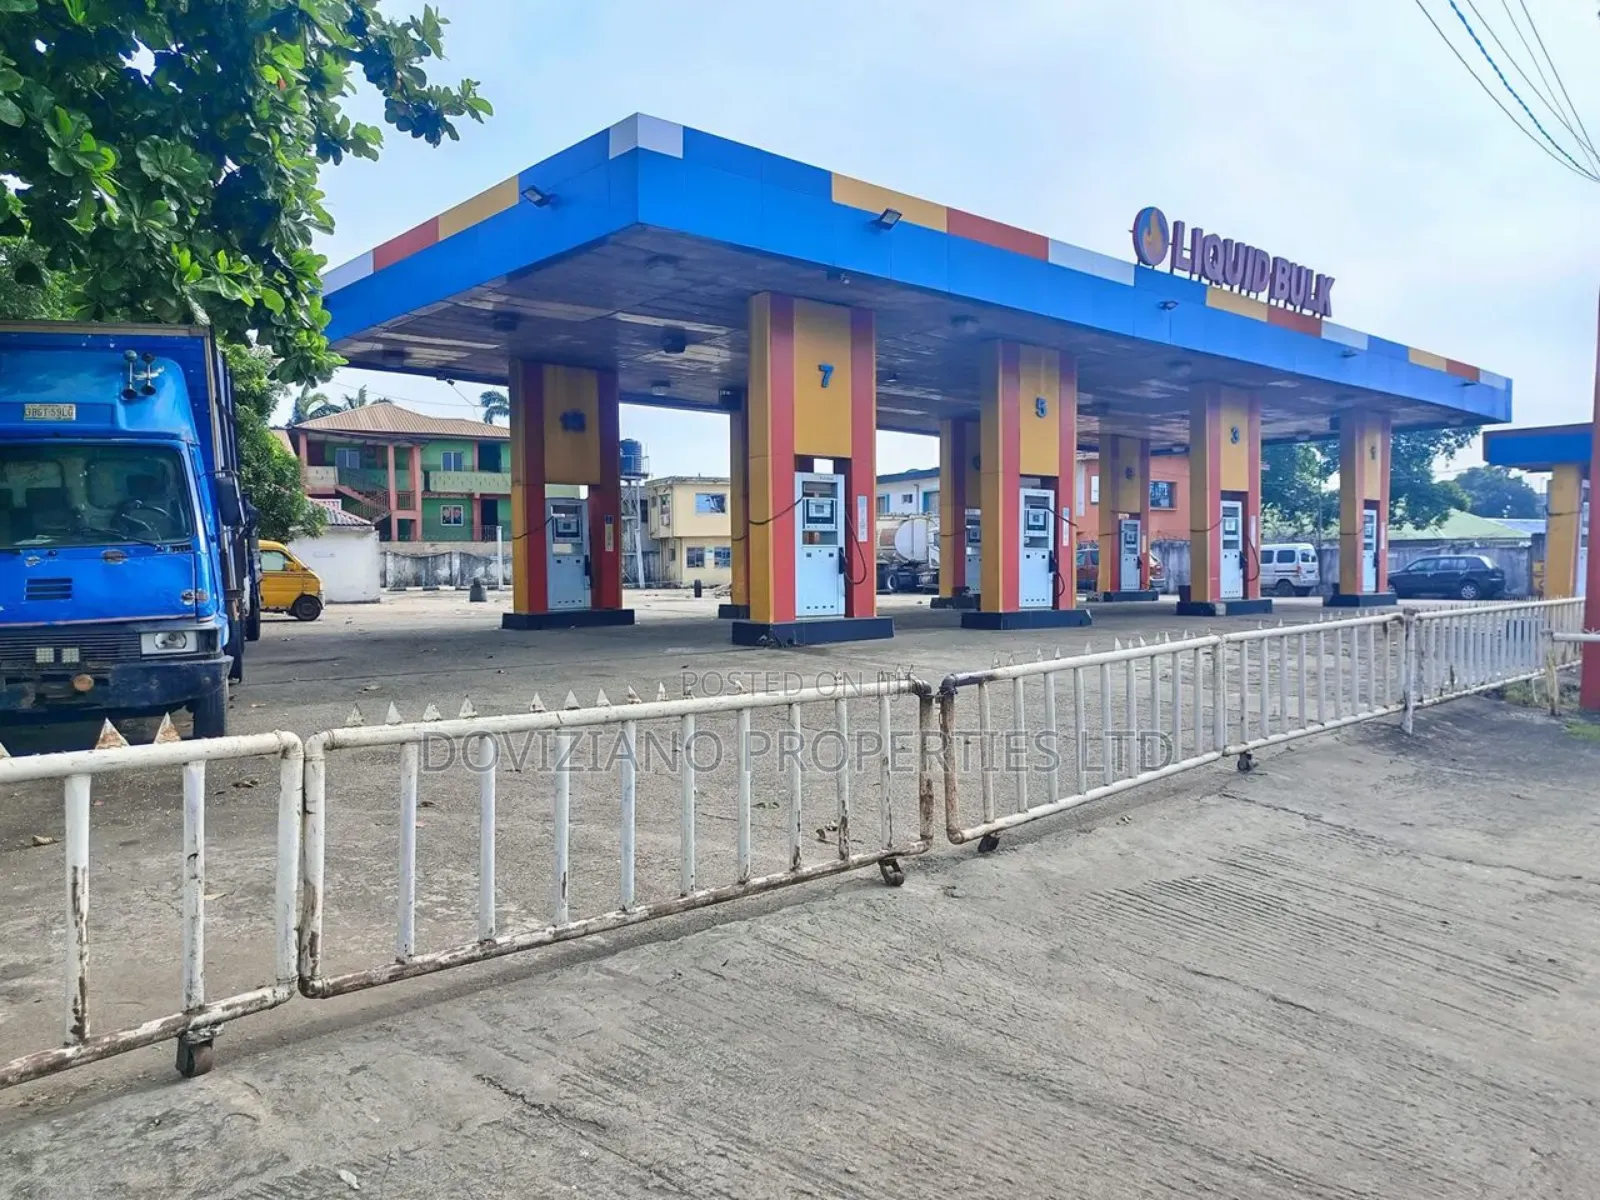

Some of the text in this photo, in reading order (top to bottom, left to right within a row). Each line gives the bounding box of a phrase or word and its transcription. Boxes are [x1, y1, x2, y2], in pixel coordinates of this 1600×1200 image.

[1171, 219, 1336, 318] LIQUID BULK
[818, 364, 834, 388] 7
[1034, 396, 1048, 419] 5
